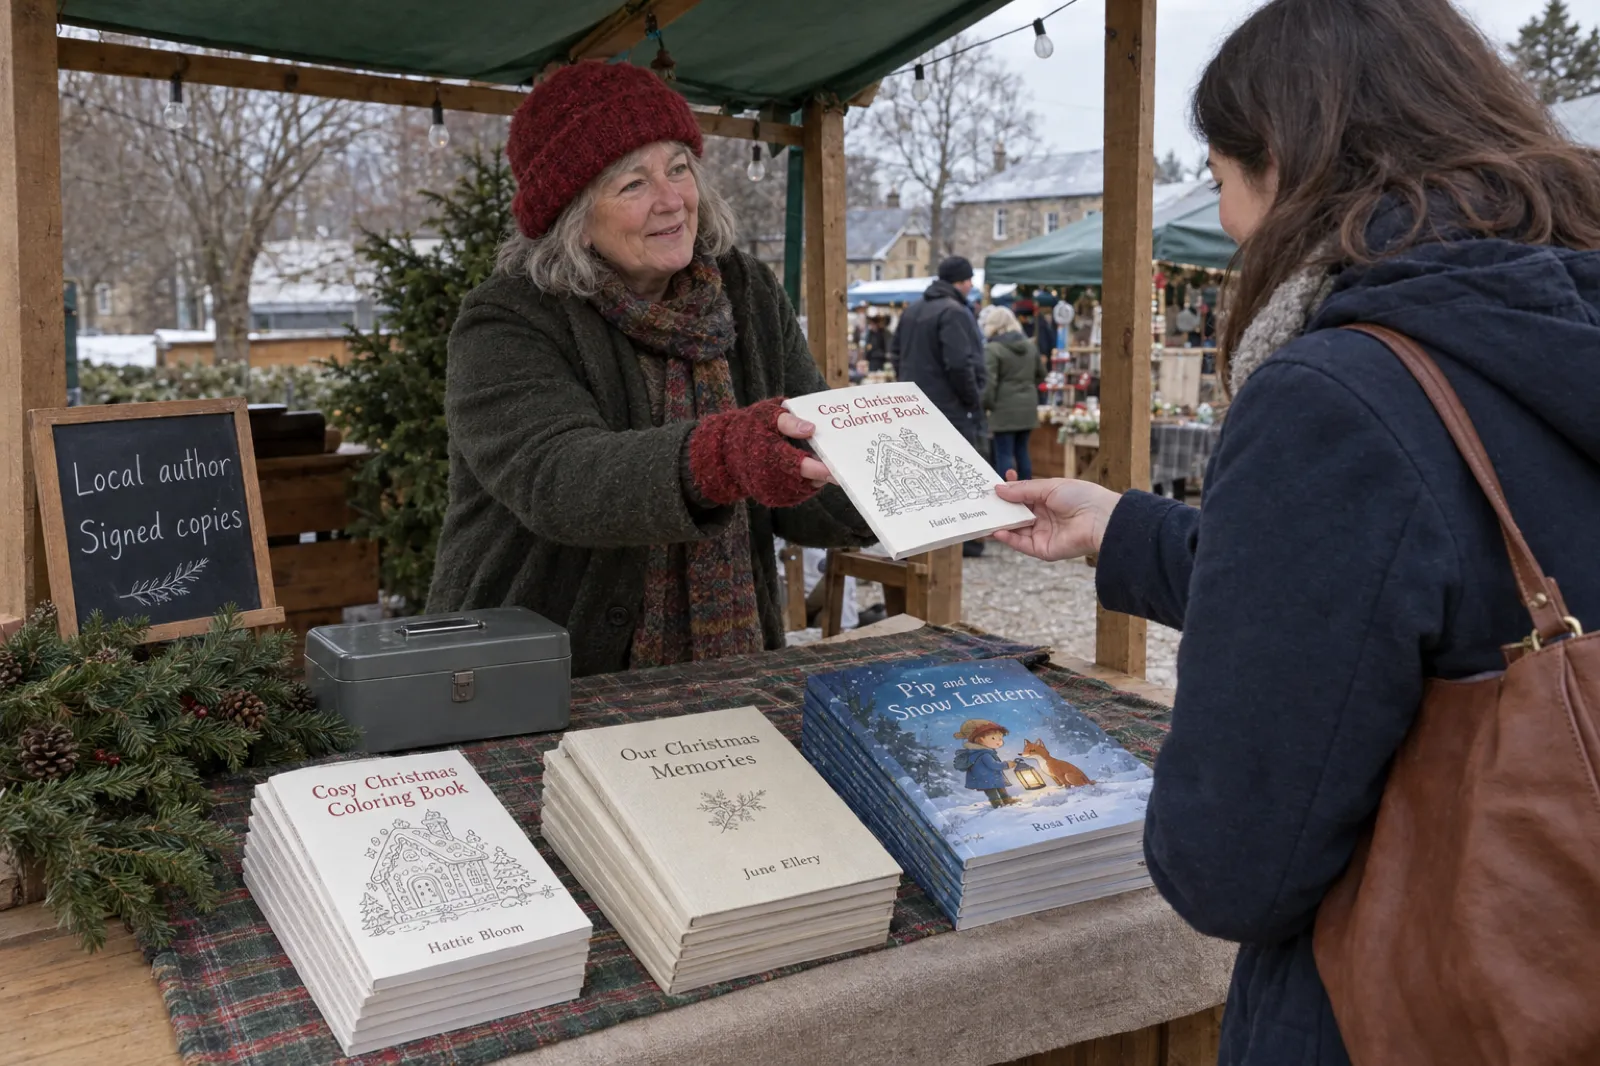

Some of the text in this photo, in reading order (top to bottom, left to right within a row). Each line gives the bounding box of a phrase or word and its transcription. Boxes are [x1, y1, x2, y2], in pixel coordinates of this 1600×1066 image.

[818, 394, 919, 416] Cosy Christmas
[831, 404, 929, 429] Coloring Book
[73, 448, 231, 496] Local author
[80, 507, 242, 560] Signed copies
[896, 674, 994, 699] Pip and the
[887, 688, 1044, 721] Snow Lantern
[620, 734, 760, 762] Our Christmas
[649, 754, 757, 780] Memories
[312, 766, 458, 801] Cosy Christmas
[327, 780, 469, 817] Coloring Book
[1031, 809, 1099, 832] Rosa Field
[742, 855, 821, 881] June Ellery
[427, 924, 525, 954] Hattie Bloom
